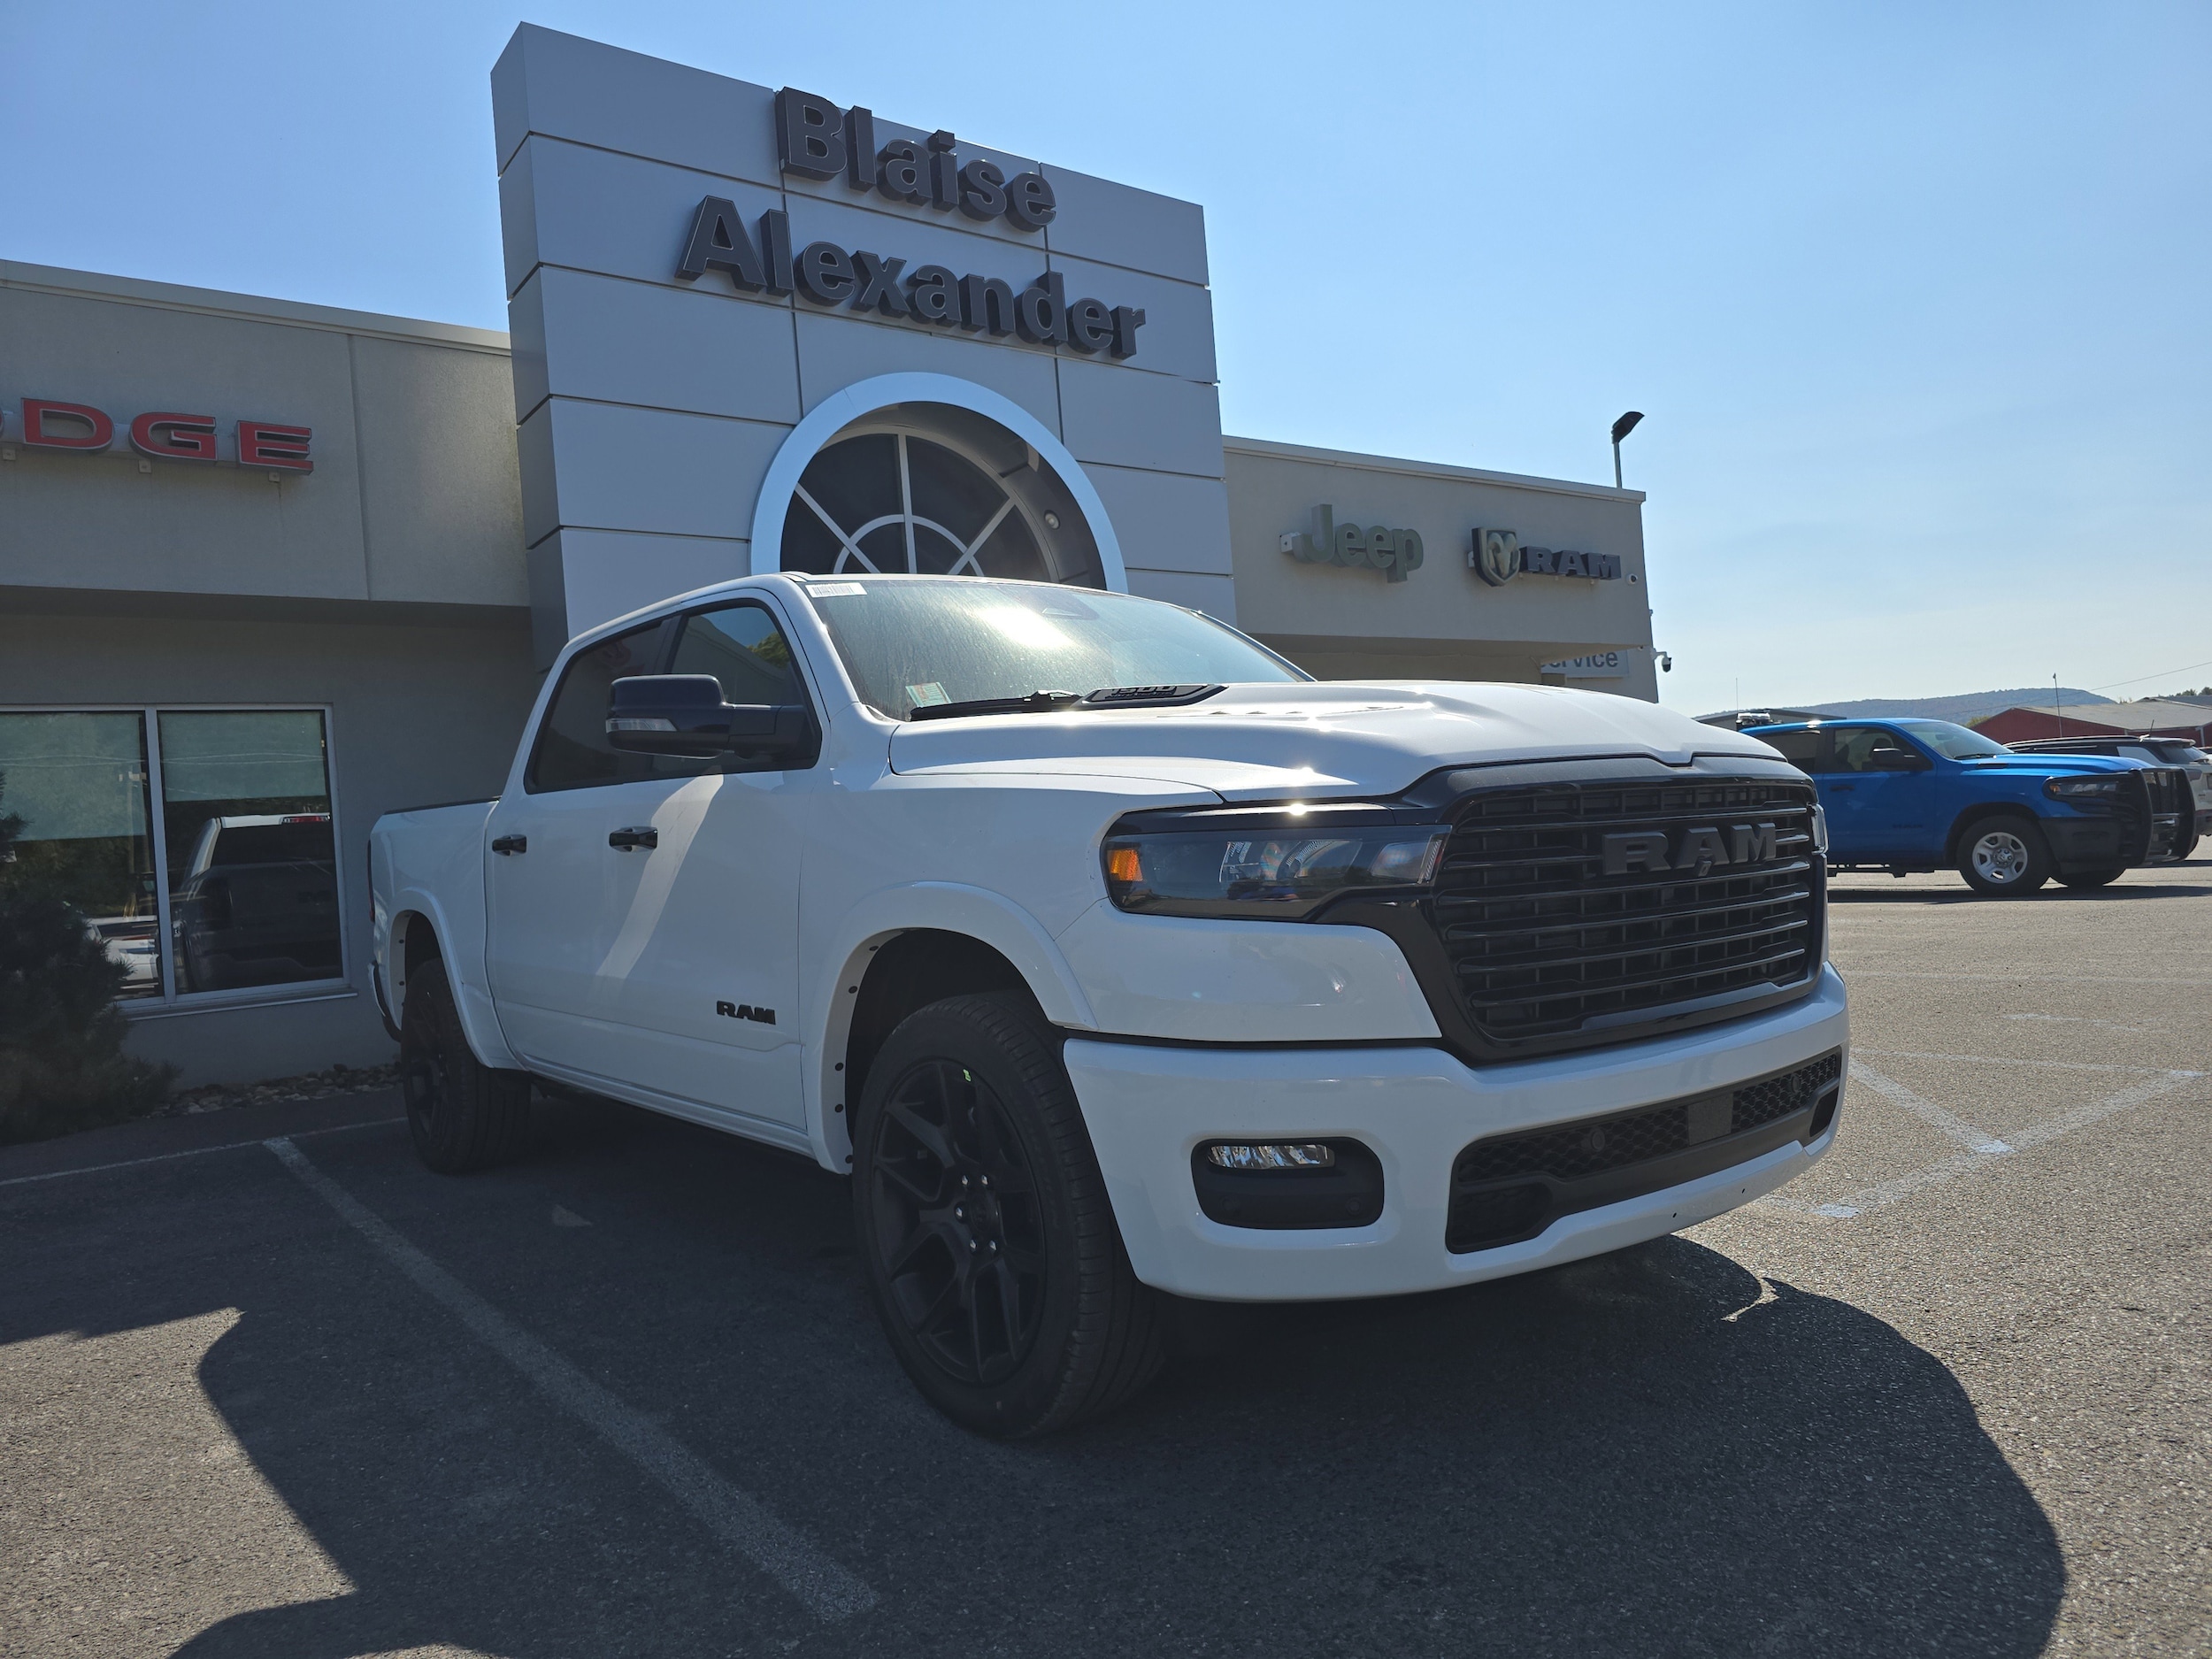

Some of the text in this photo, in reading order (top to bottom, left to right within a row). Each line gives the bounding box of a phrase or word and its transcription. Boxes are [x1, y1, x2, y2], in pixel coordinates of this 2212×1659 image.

[775, 86, 1056, 232] Blaise
[675, 195, 1145, 359] Alexander
[0, 397, 314, 475] DGE
[1292, 503, 1424, 583] Jeep
[1519, 546, 1621, 580] RAM
[1602, 822, 1777, 875] RAM
[716, 1000, 777, 1025] RAM
